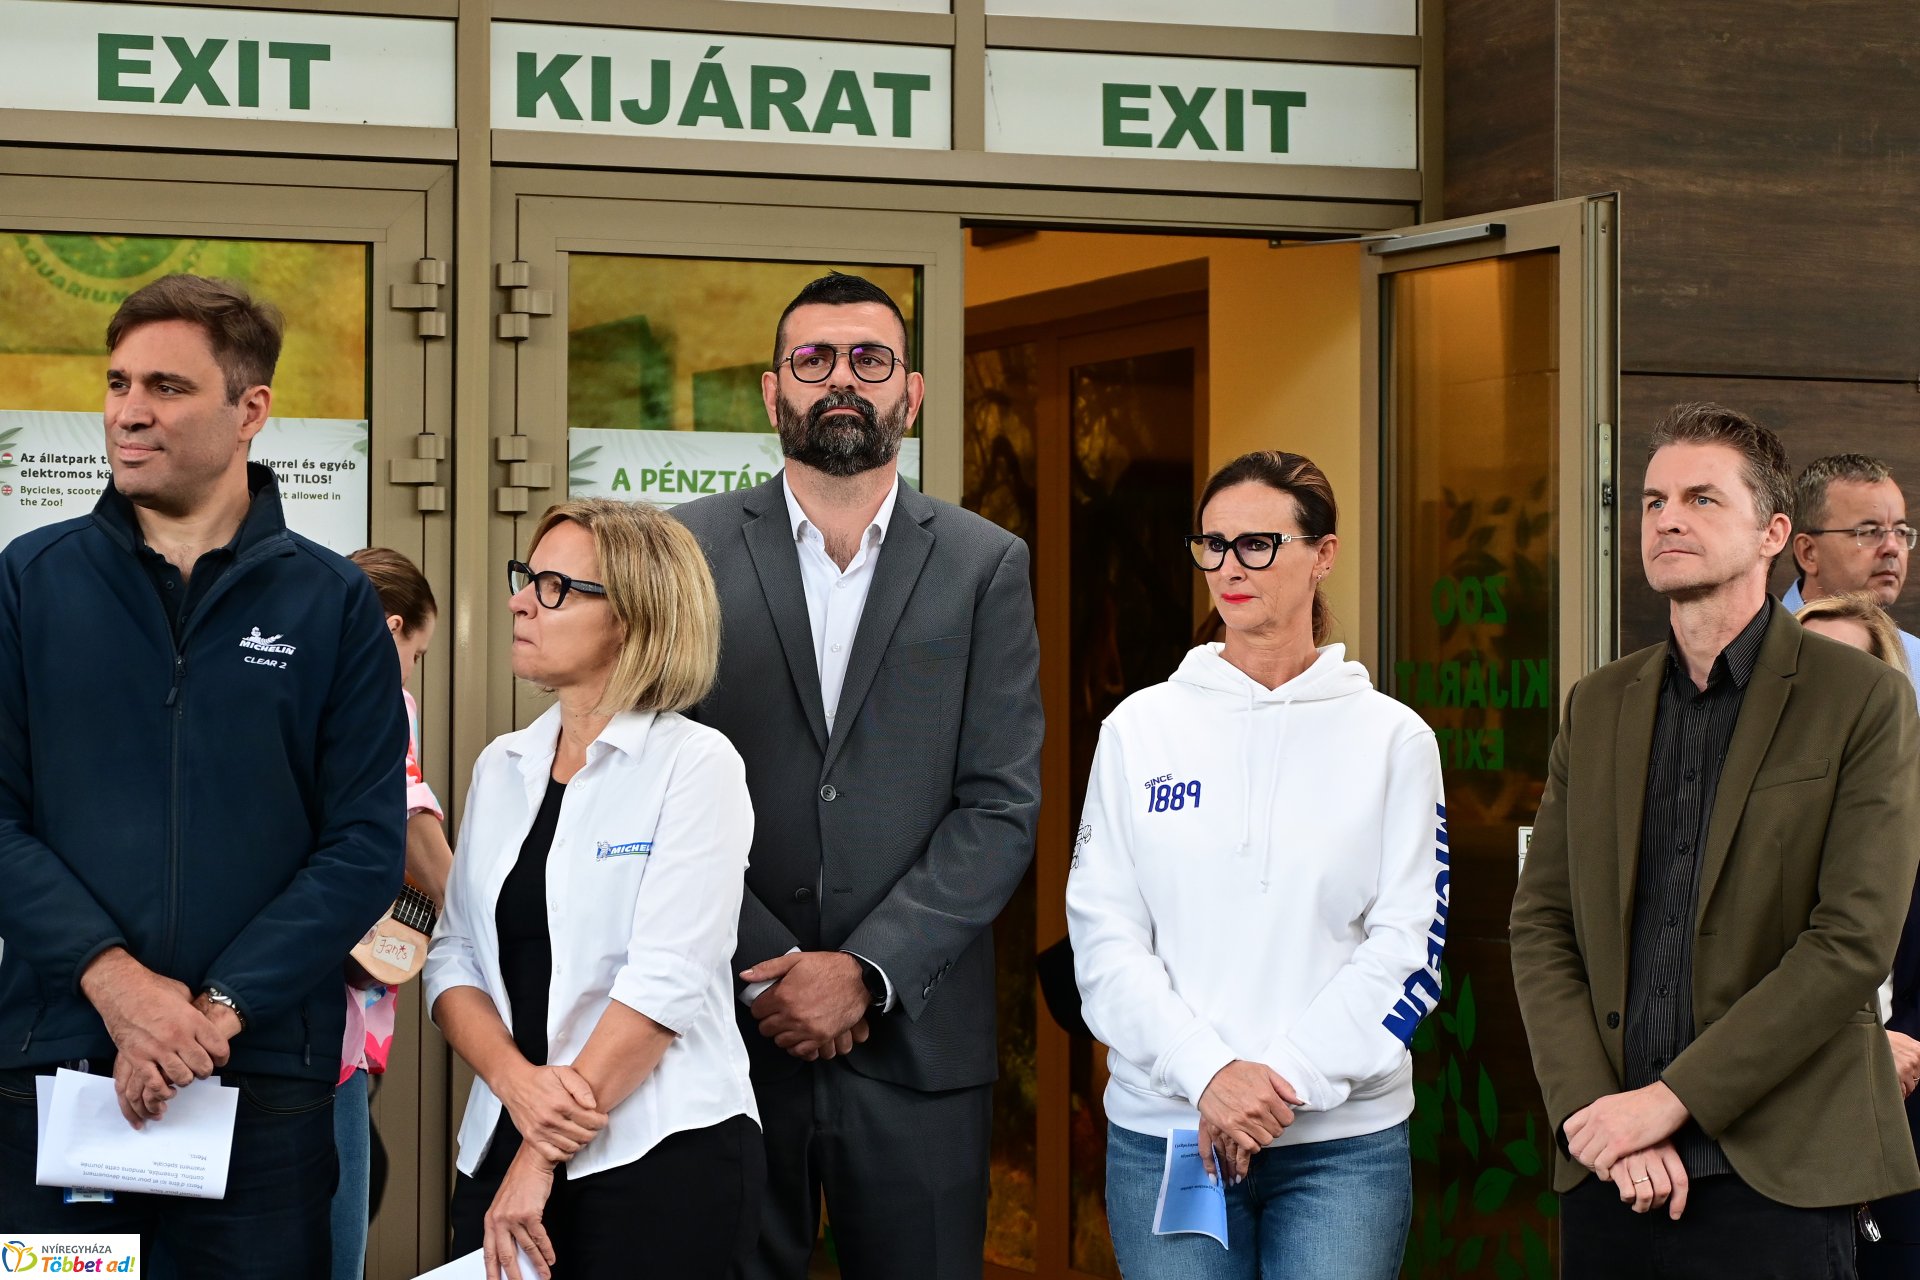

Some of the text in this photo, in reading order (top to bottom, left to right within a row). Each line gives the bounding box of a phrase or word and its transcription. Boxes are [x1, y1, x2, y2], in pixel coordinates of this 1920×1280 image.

[98, 33, 330, 109] EXIT
[517, 46, 930, 137] KIJÁRAT
[1104, 83, 1307, 153] EXIT
[20, 453, 35, 463] Az
[40, 453, 97, 466] állatpark
[302, 459, 315, 469] és
[320, 460, 356, 472] egyéb
[20, 468, 93, 479] elektromos
[293, 474, 332, 484] TILOS!
[611, 467, 631, 492] A
[20, 486, 64, 496] Bycicles,
[67, 487, 103, 496] scoote
[291, 492, 329, 500] allowed
[332, 492, 341, 500] in
[20, 498, 63, 507] the Zoo!
[239, 640, 295, 655] MICHELIN
[244, 656, 287, 669] CLEAR 2
[1144, 773, 1174, 789] SINCE
[1148, 780, 1201, 813] 1889
[610, 844, 650, 855] MICHEL
